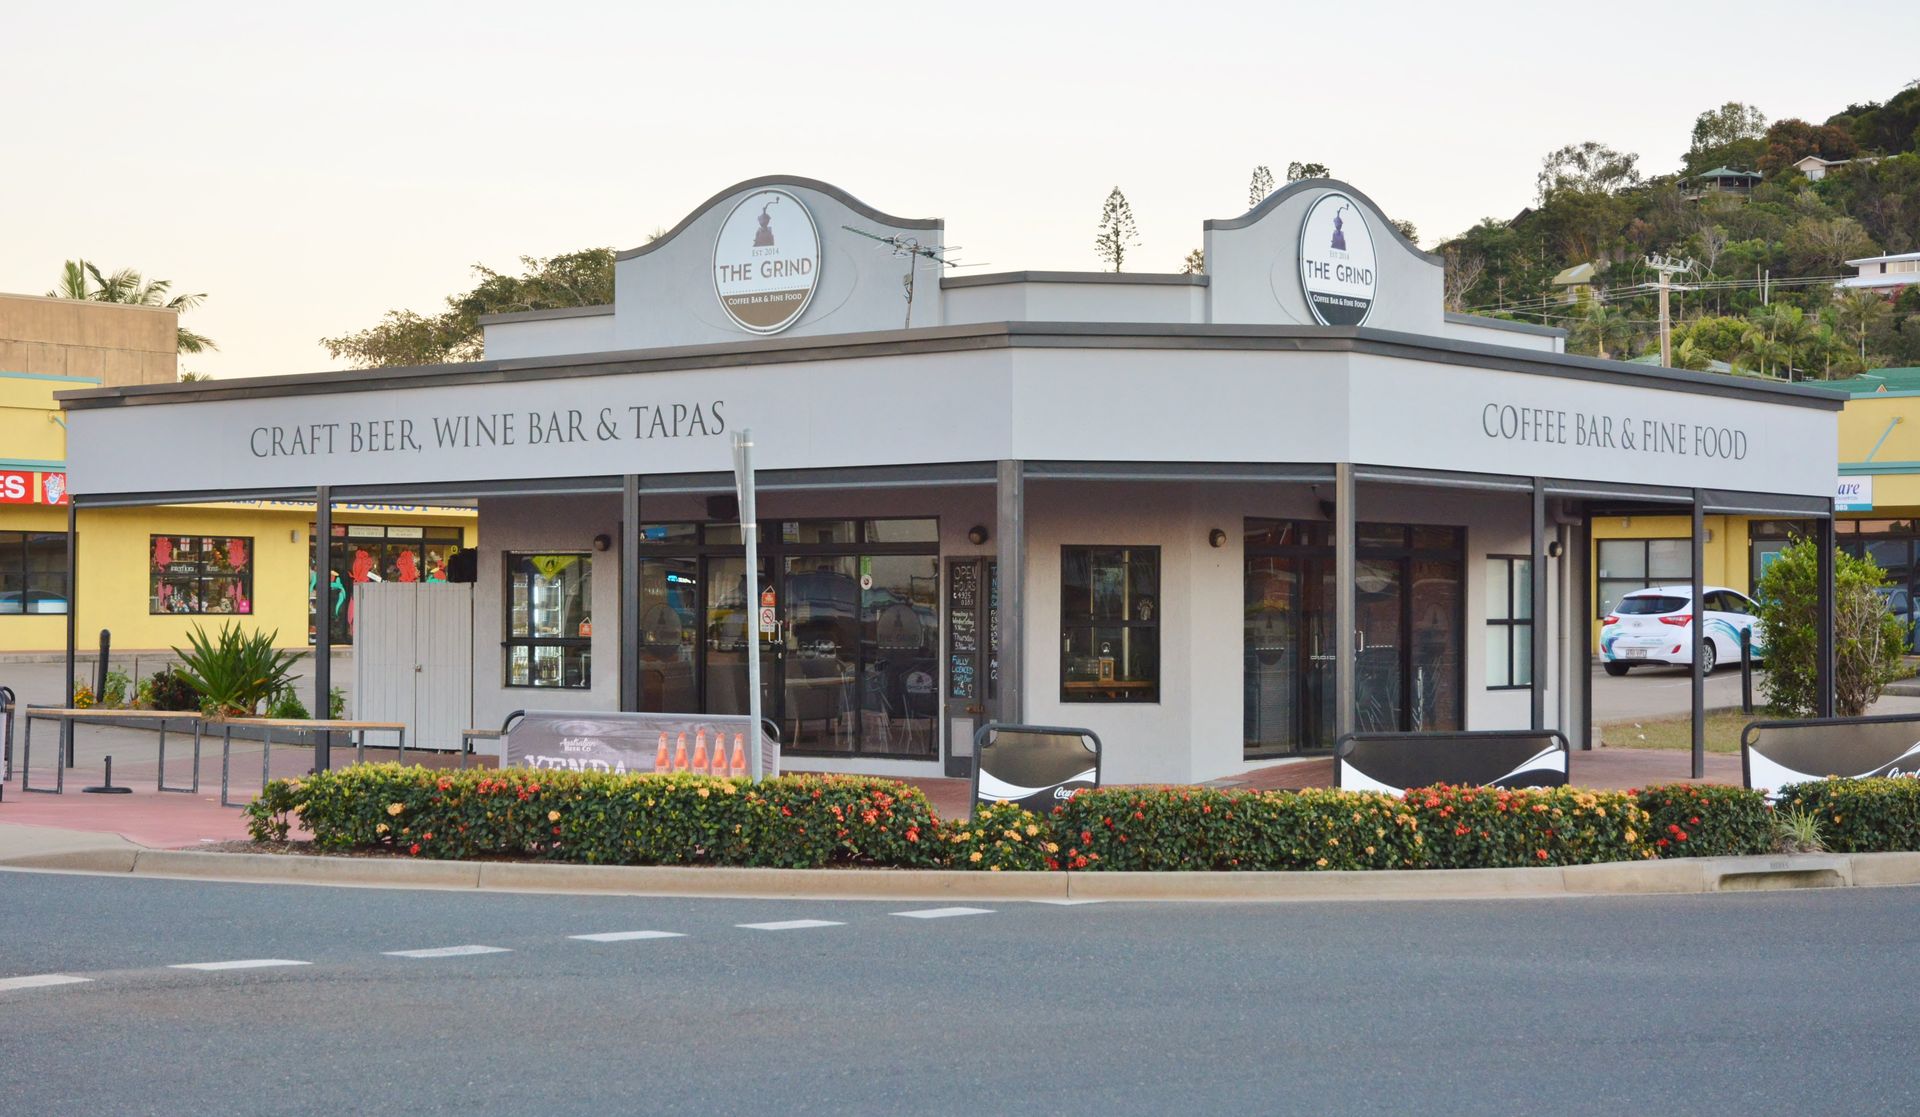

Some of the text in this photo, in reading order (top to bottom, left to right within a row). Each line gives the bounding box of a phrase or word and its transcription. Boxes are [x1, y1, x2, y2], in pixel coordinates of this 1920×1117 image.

[719, 258, 812, 283] THE GRIND
[1306, 260, 1373, 286] THE GRIND
[751, 296, 763, 304] BAR
[764, 295, 769, 303] &
[250, 400, 725, 458] CRAFT BEER, WINE BAR & TAPAS
[1482, 403, 1747, 460] COFFEE BAR & FINE FOOD
[953, 565, 977, 580] OPEN
[953, 580, 976, 592] HOURS
